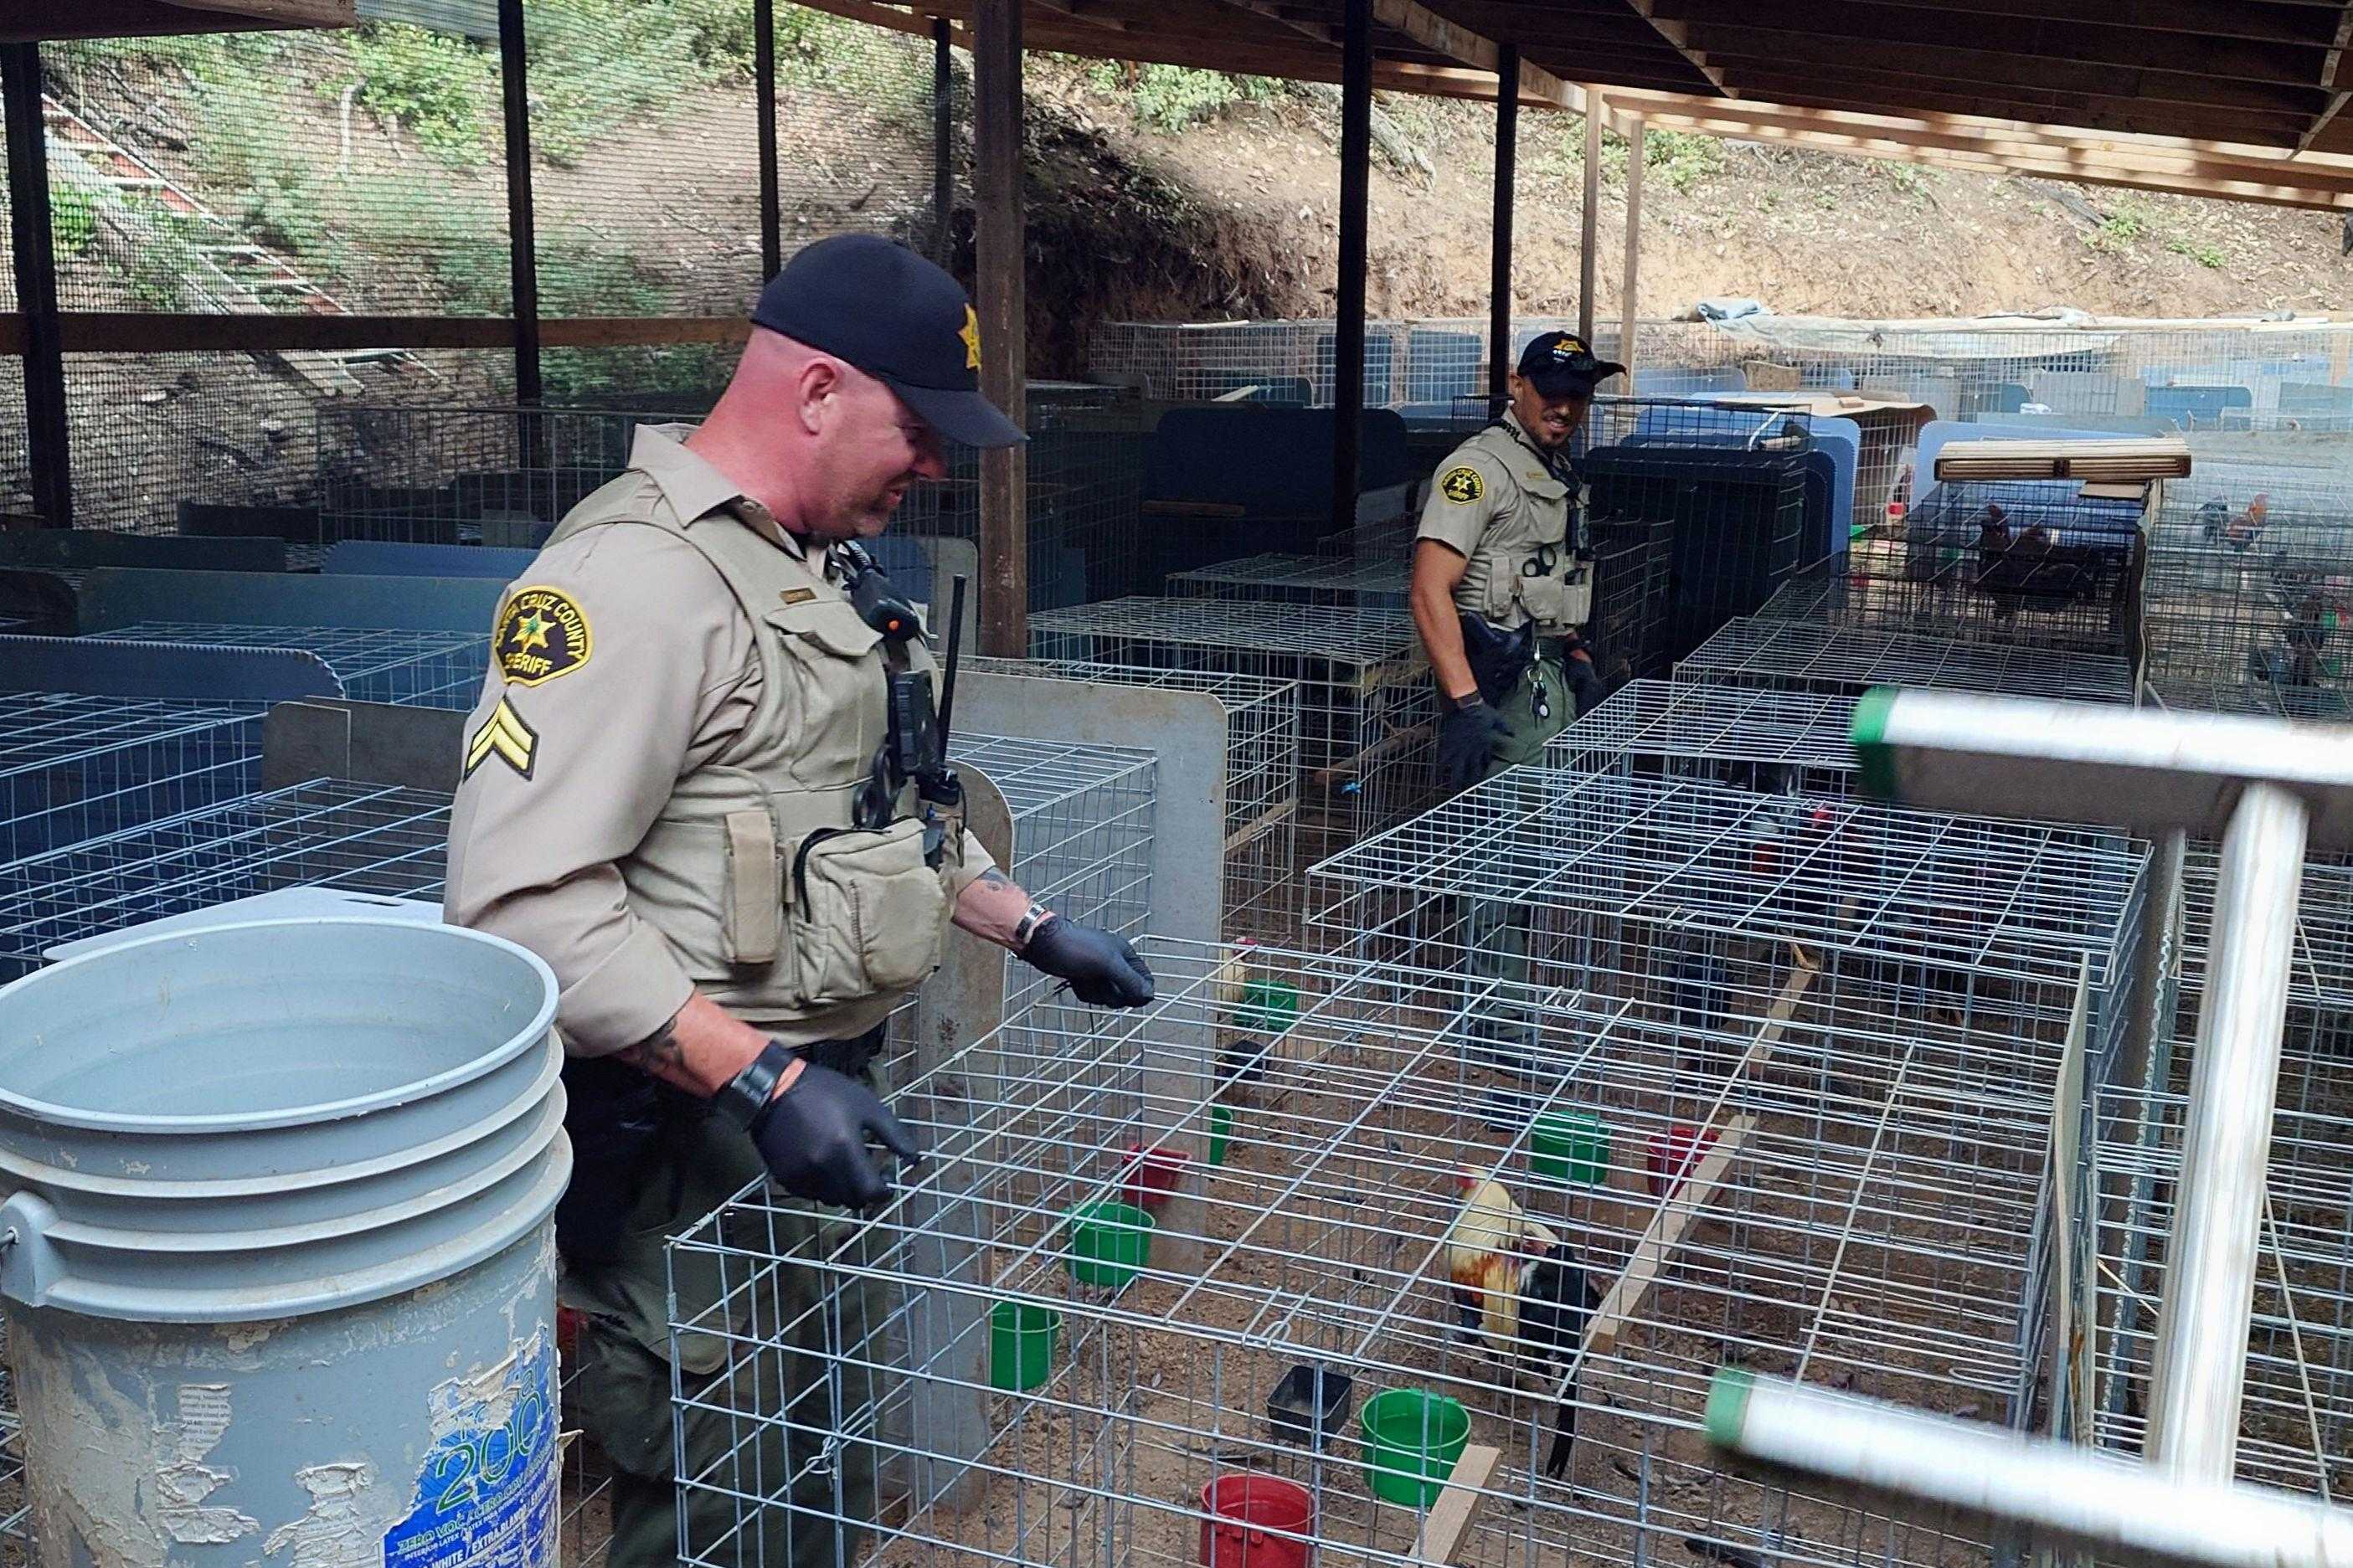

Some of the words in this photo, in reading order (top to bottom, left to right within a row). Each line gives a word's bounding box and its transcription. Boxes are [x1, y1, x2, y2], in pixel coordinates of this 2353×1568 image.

[520, 594, 560, 611] CRUZ
[553, 602, 585, 660] COUNTY
[504, 652, 553, 676] SERIFF
[436, 1391, 543, 1514] 200
[397, 1529, 435, 1555] ZERO
[435, 1515, 471, 1540] VOC
[438, 1531, 461, 1548] LATEX
[431, 1549, 464, 1568] WHITE
